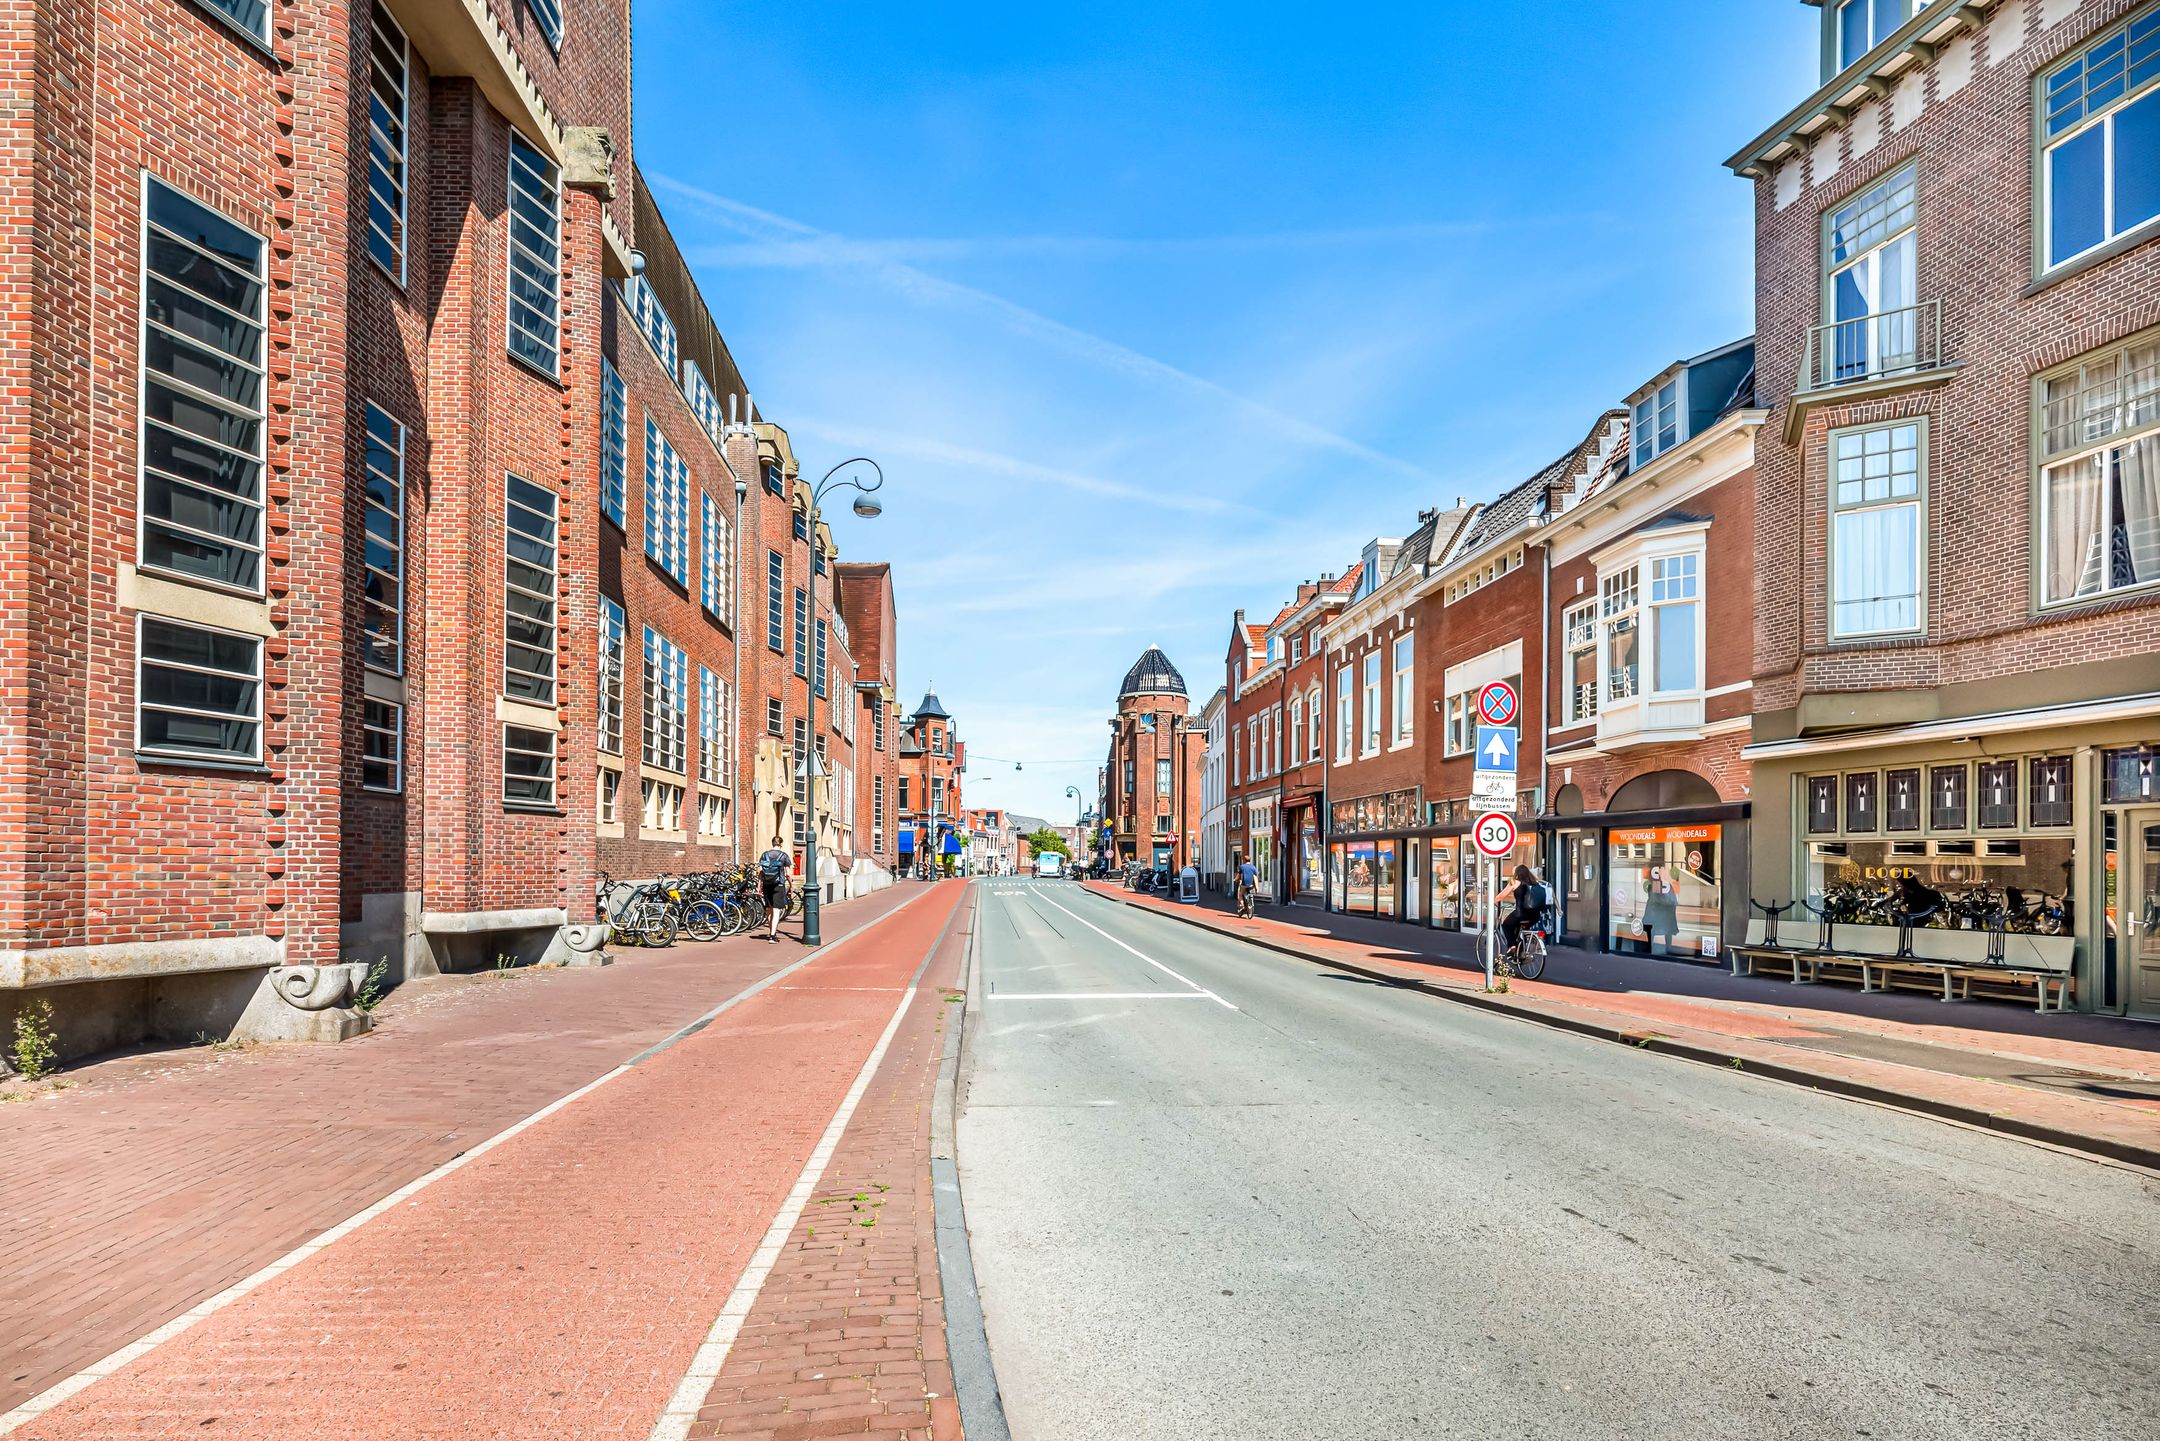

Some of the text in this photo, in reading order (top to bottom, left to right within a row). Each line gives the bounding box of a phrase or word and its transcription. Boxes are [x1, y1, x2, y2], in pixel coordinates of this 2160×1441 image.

[1483, 827, 1508, 842] 30
[1620, 832, 1656, 841] WOONDEALS
[1666, 829, 1708, 839] WOONDEALS
[1865, 867, 1914, 880] ROOD
